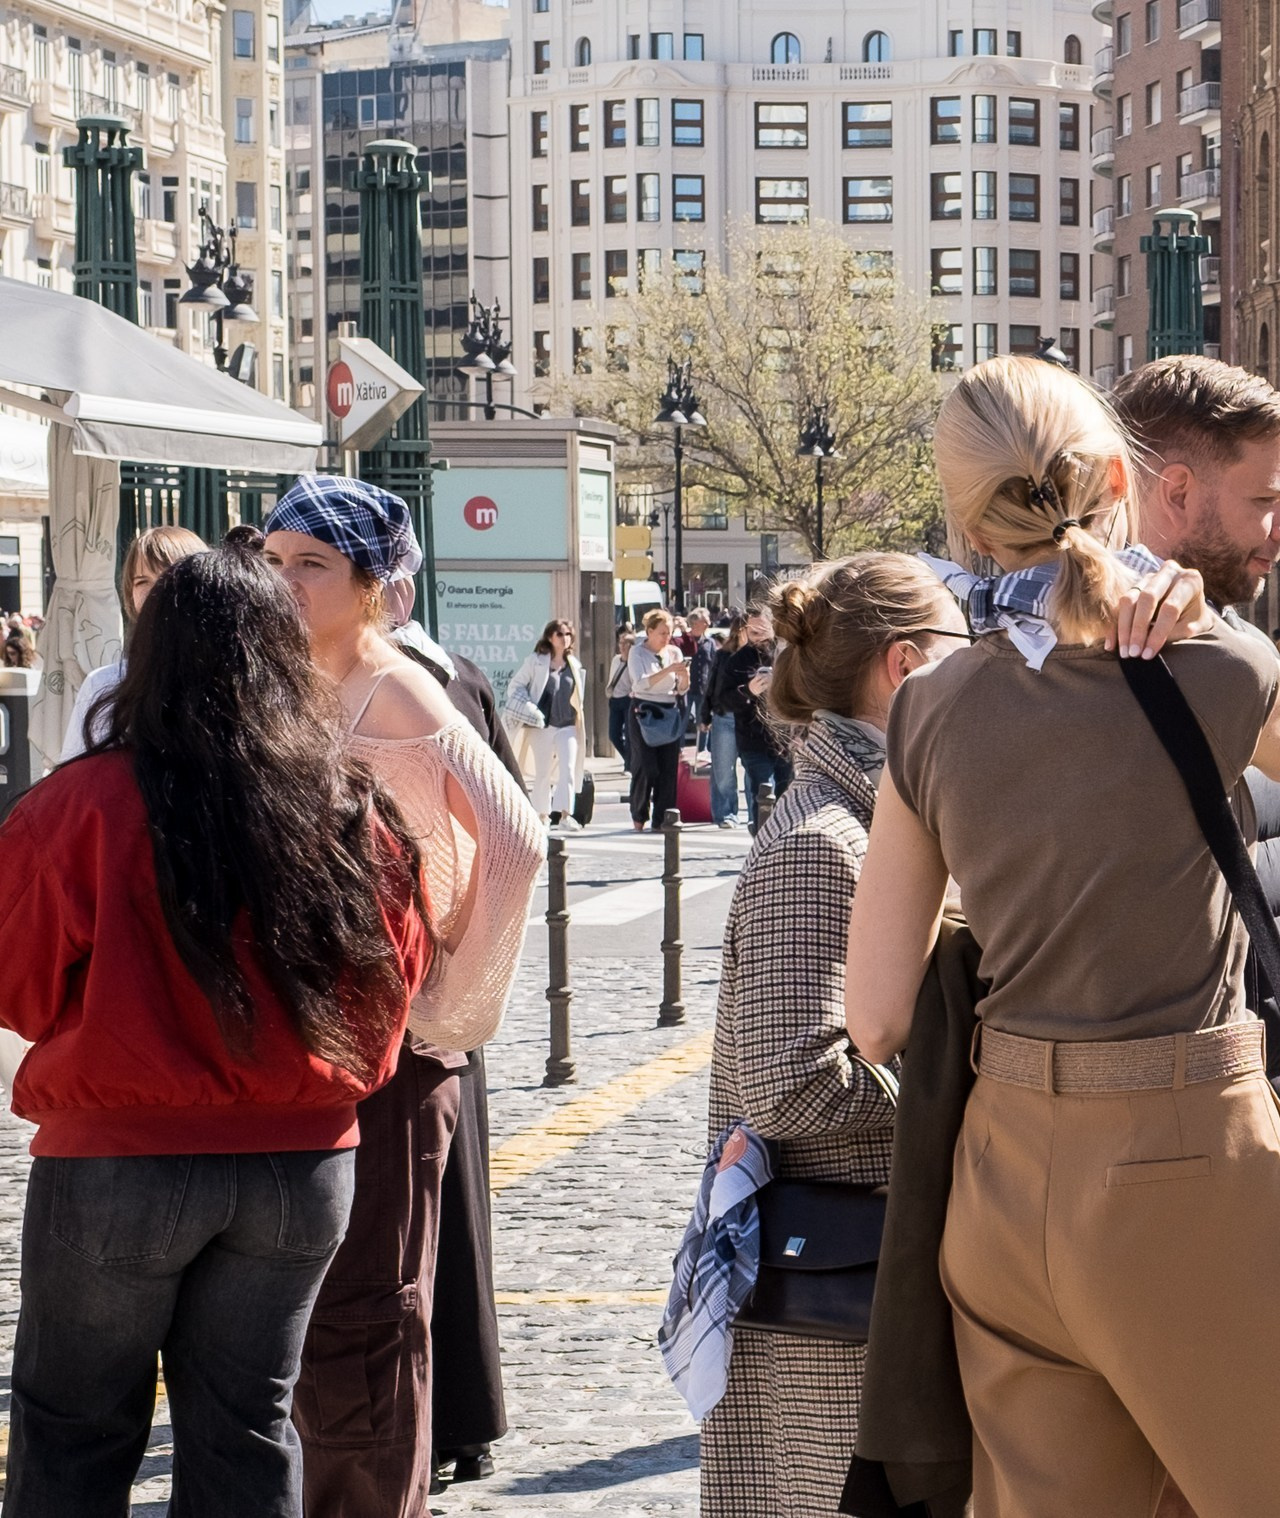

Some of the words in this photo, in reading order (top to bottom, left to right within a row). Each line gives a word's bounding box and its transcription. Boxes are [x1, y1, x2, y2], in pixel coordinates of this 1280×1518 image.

[447, 585, 474, 595] Gana
[454, 623, 535, 641] FALLAS
[459, 644, 519, 662] PARA
